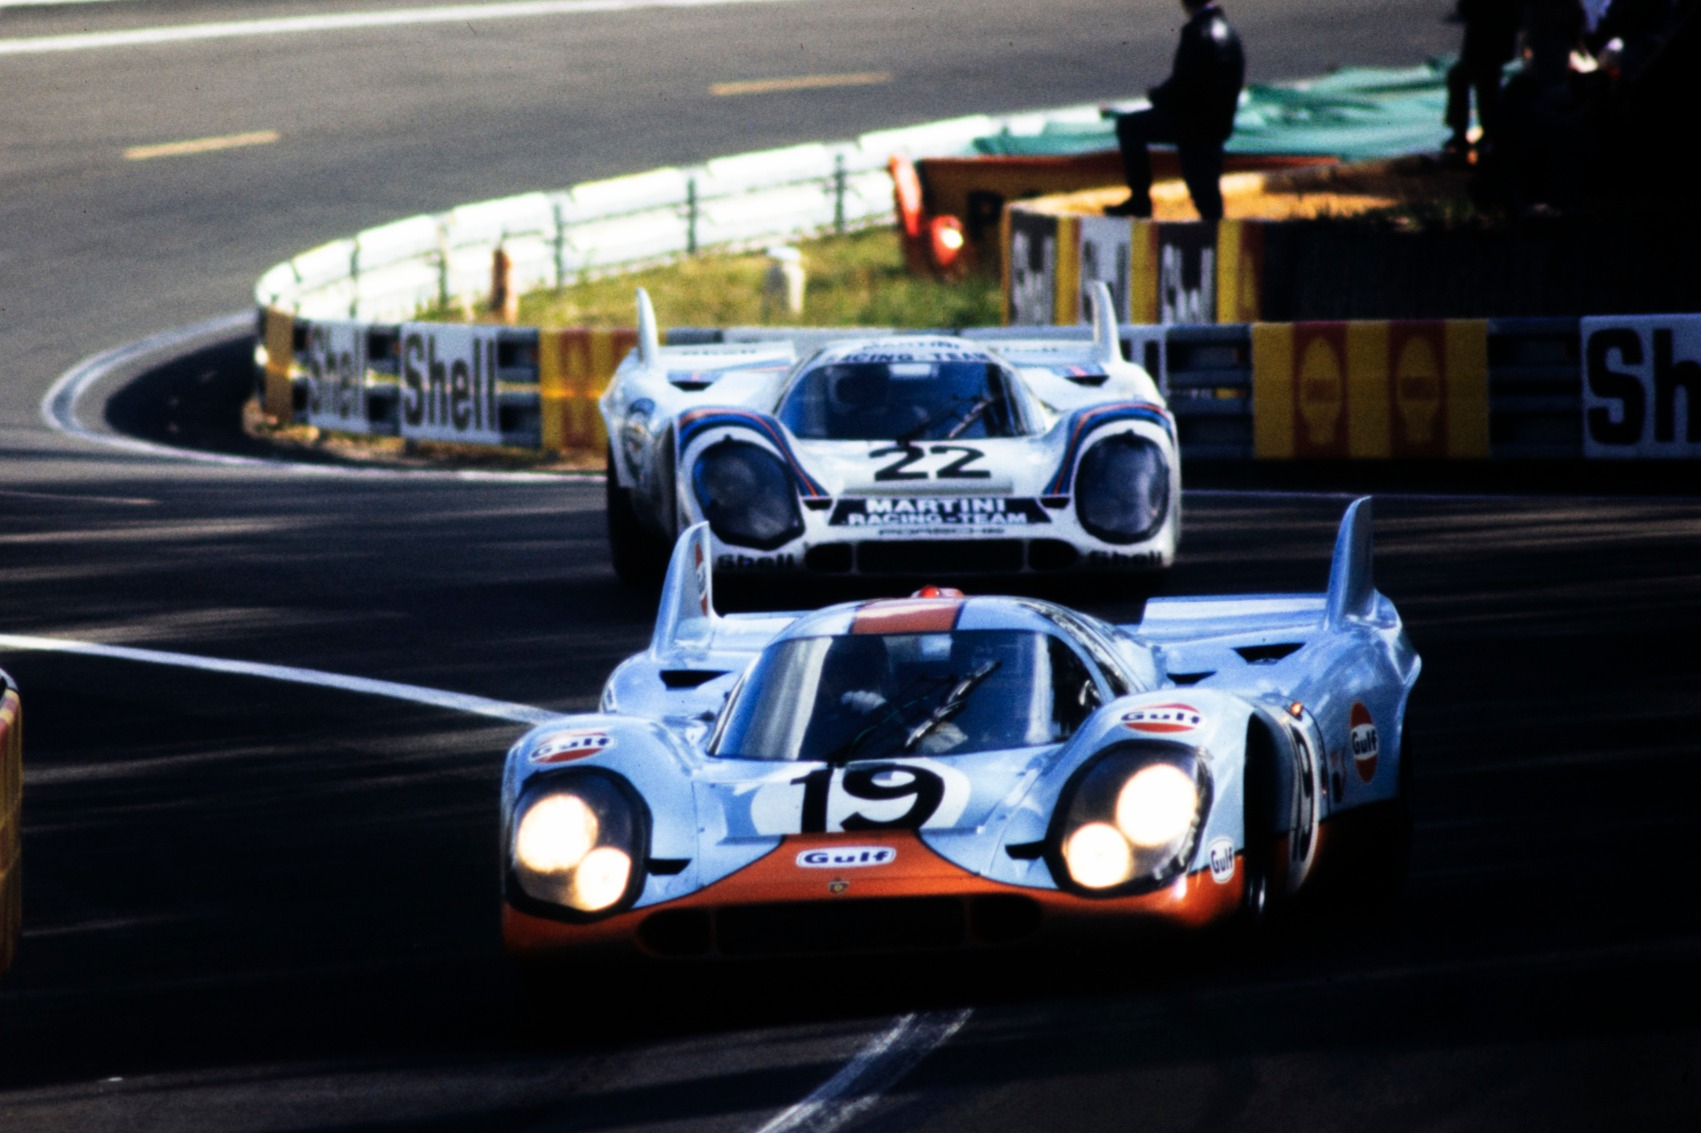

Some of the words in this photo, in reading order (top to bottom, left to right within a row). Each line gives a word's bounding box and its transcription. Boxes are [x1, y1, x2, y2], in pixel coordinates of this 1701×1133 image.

[404, 333, 497, 430] Shell
[869, 445, 991, 481] 22
[866, 498, 1006, 514] MARTINI
[717, 554, 795, 569] Shell
[1122, 711, 1202, 723] Gulf
[531, 734, 612, 755] Gulf
[1351, 729, 1377, 757] Gulf
[790, 763, 946, 834] 19
[803, 849, 891, 865] Gulf
[1211, 848, 1234, 876] Gulf
